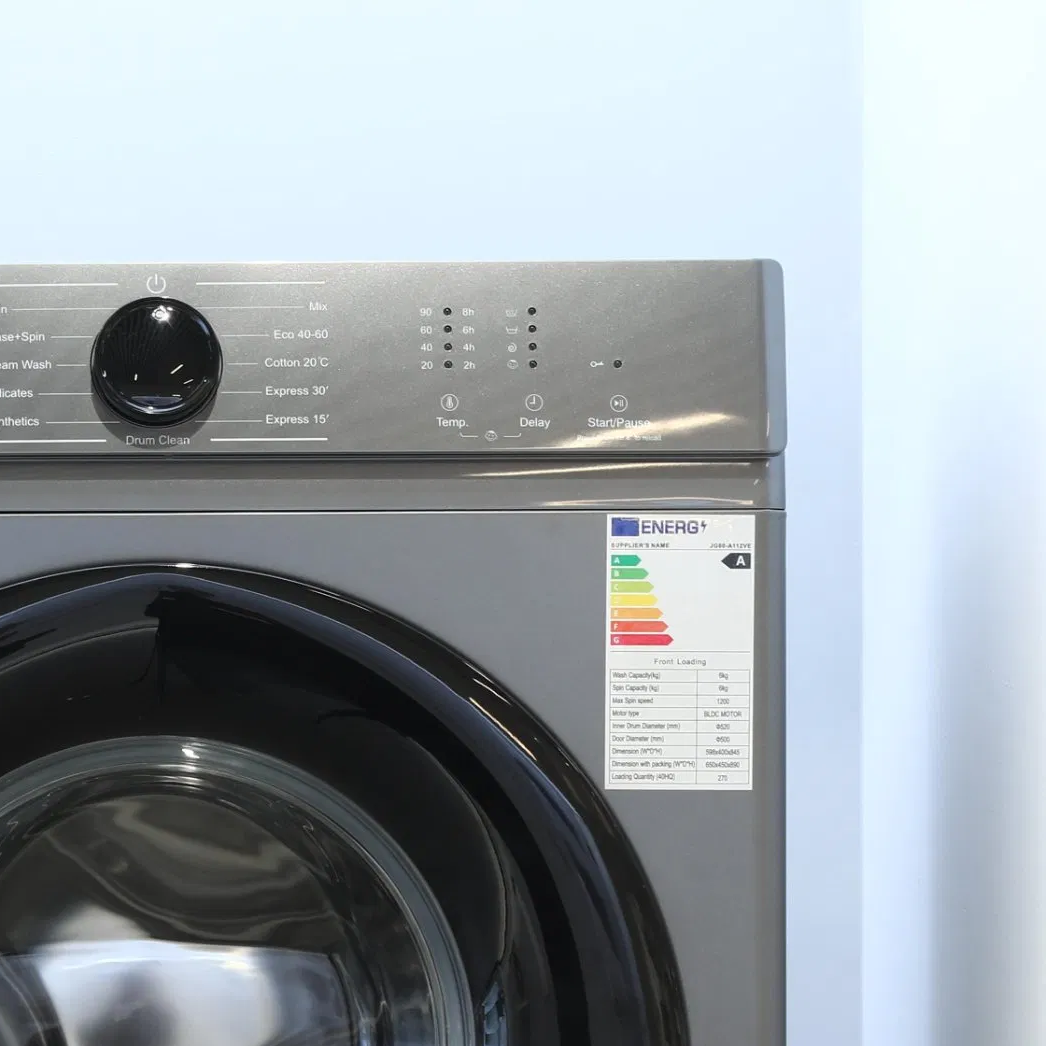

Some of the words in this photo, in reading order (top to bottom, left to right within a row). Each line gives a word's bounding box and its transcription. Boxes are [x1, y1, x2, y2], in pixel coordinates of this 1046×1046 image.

[309, 302, 328, 311] Mix
[420, 307, 432, 317] 90
[462, 307, 475, 317] 8h
[273, 330, 294, 339] Eco
[297, 329, 328, 339] 40-60
[420, 325, 432, 335] 60
[462, 325, 475, 335] 6h
[420, 343, 433, 352] 40
[463, 342, 475, 352] 4h
[22, 359, 52, 369] Wash
[264, 358, 300, 368] Cotton
[421, 361, 433, 370] 20
[463, 361, 475, 370] 2h
[265, 386, 308, 397] Express
[266, 414, 309, 426] Express
[436, 417, 469, 430] Temp.
[520, 417, 551, 430] Delay
[587, 417, 651, 428] Start/Pause
[126, 435, 155, 446] Drum
[159, 435, 190, 445] Clean
[736, 556, 746, 566] A
[677, 658, 706, 666] Loading
[612, 684, 624, 692] Spin
[612, 773, 632, 781] Loading
[633, 773, 655, 781] Quantity
